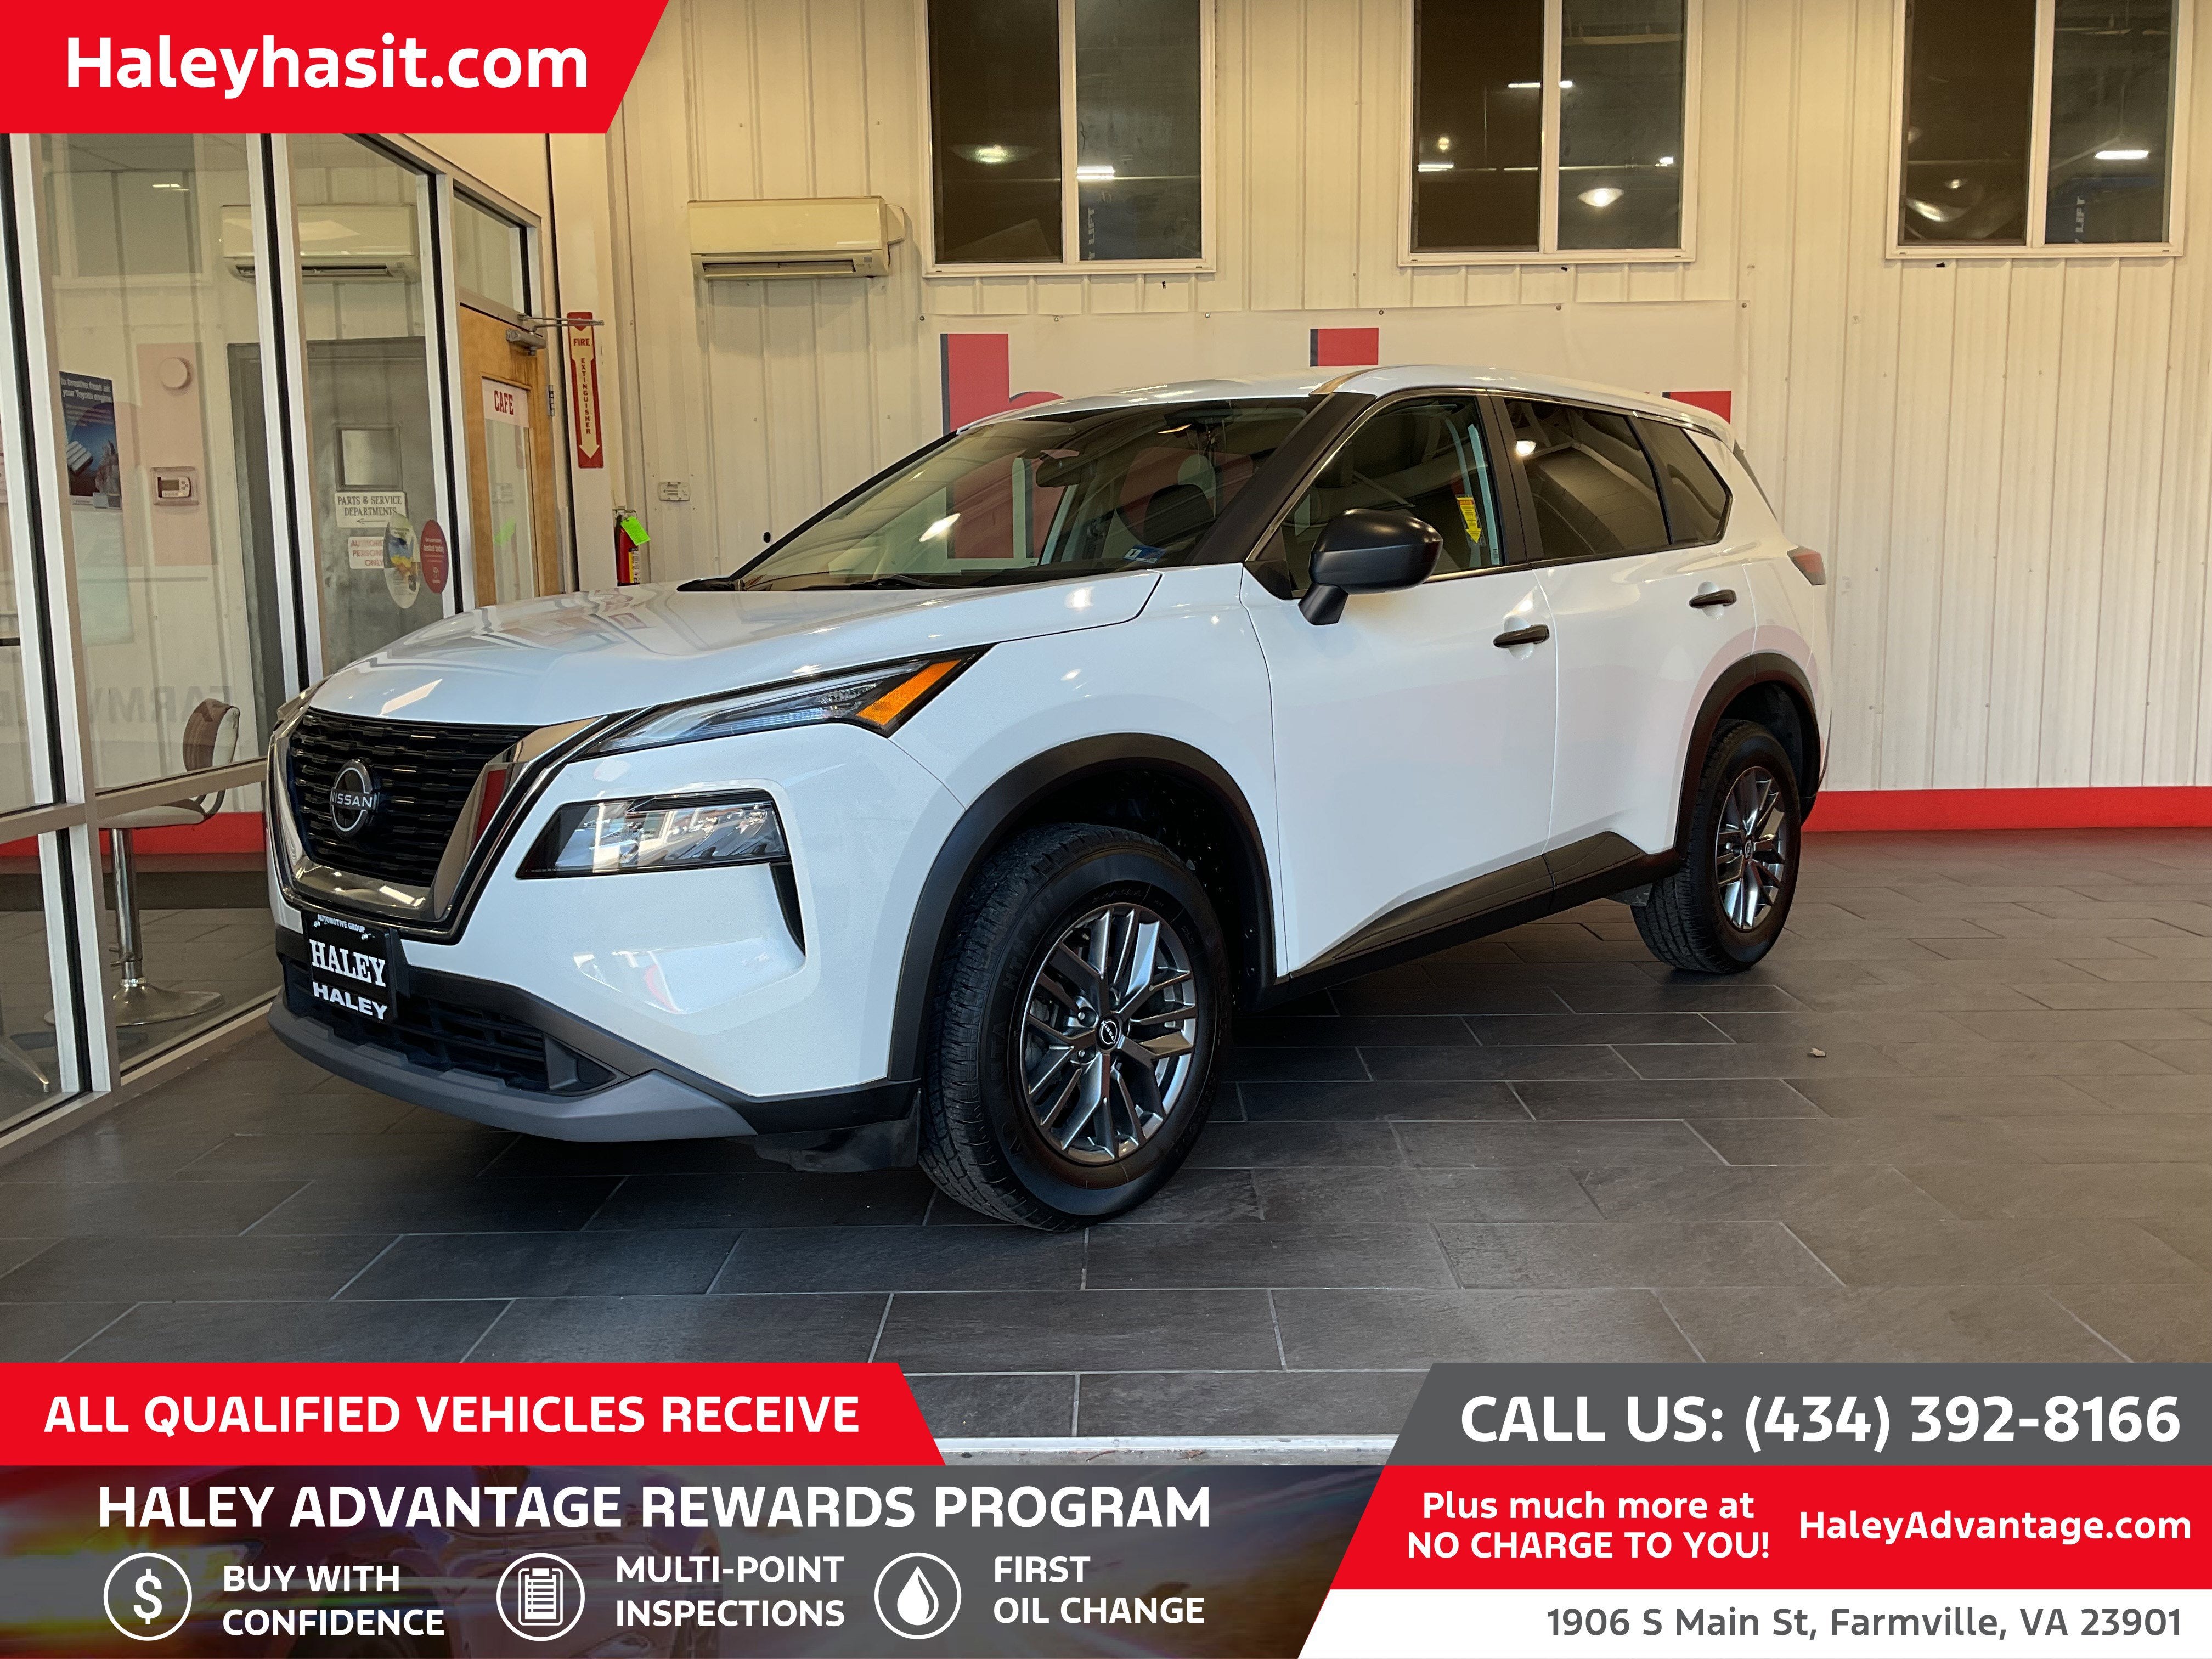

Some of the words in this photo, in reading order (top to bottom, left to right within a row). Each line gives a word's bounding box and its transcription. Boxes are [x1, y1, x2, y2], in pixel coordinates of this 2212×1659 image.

[494, 390, 514, 415] CAFE
[580, 358, 591, 434] EXTINGUISHER
[337, 496, 360, 505] PARTS
[371, 496, 403, 505] SERVICE
[344, 507, 397, 516] DEPARTMENTS
[330, 791, 373, 808] NISSAN
[317, 913, 348, 929] AUTOMOTIVE
[348, 922, 365, 933] GROUP
[309, 939, 386, 987] HALEY
[313, 981, 387, 1020] HALEY
